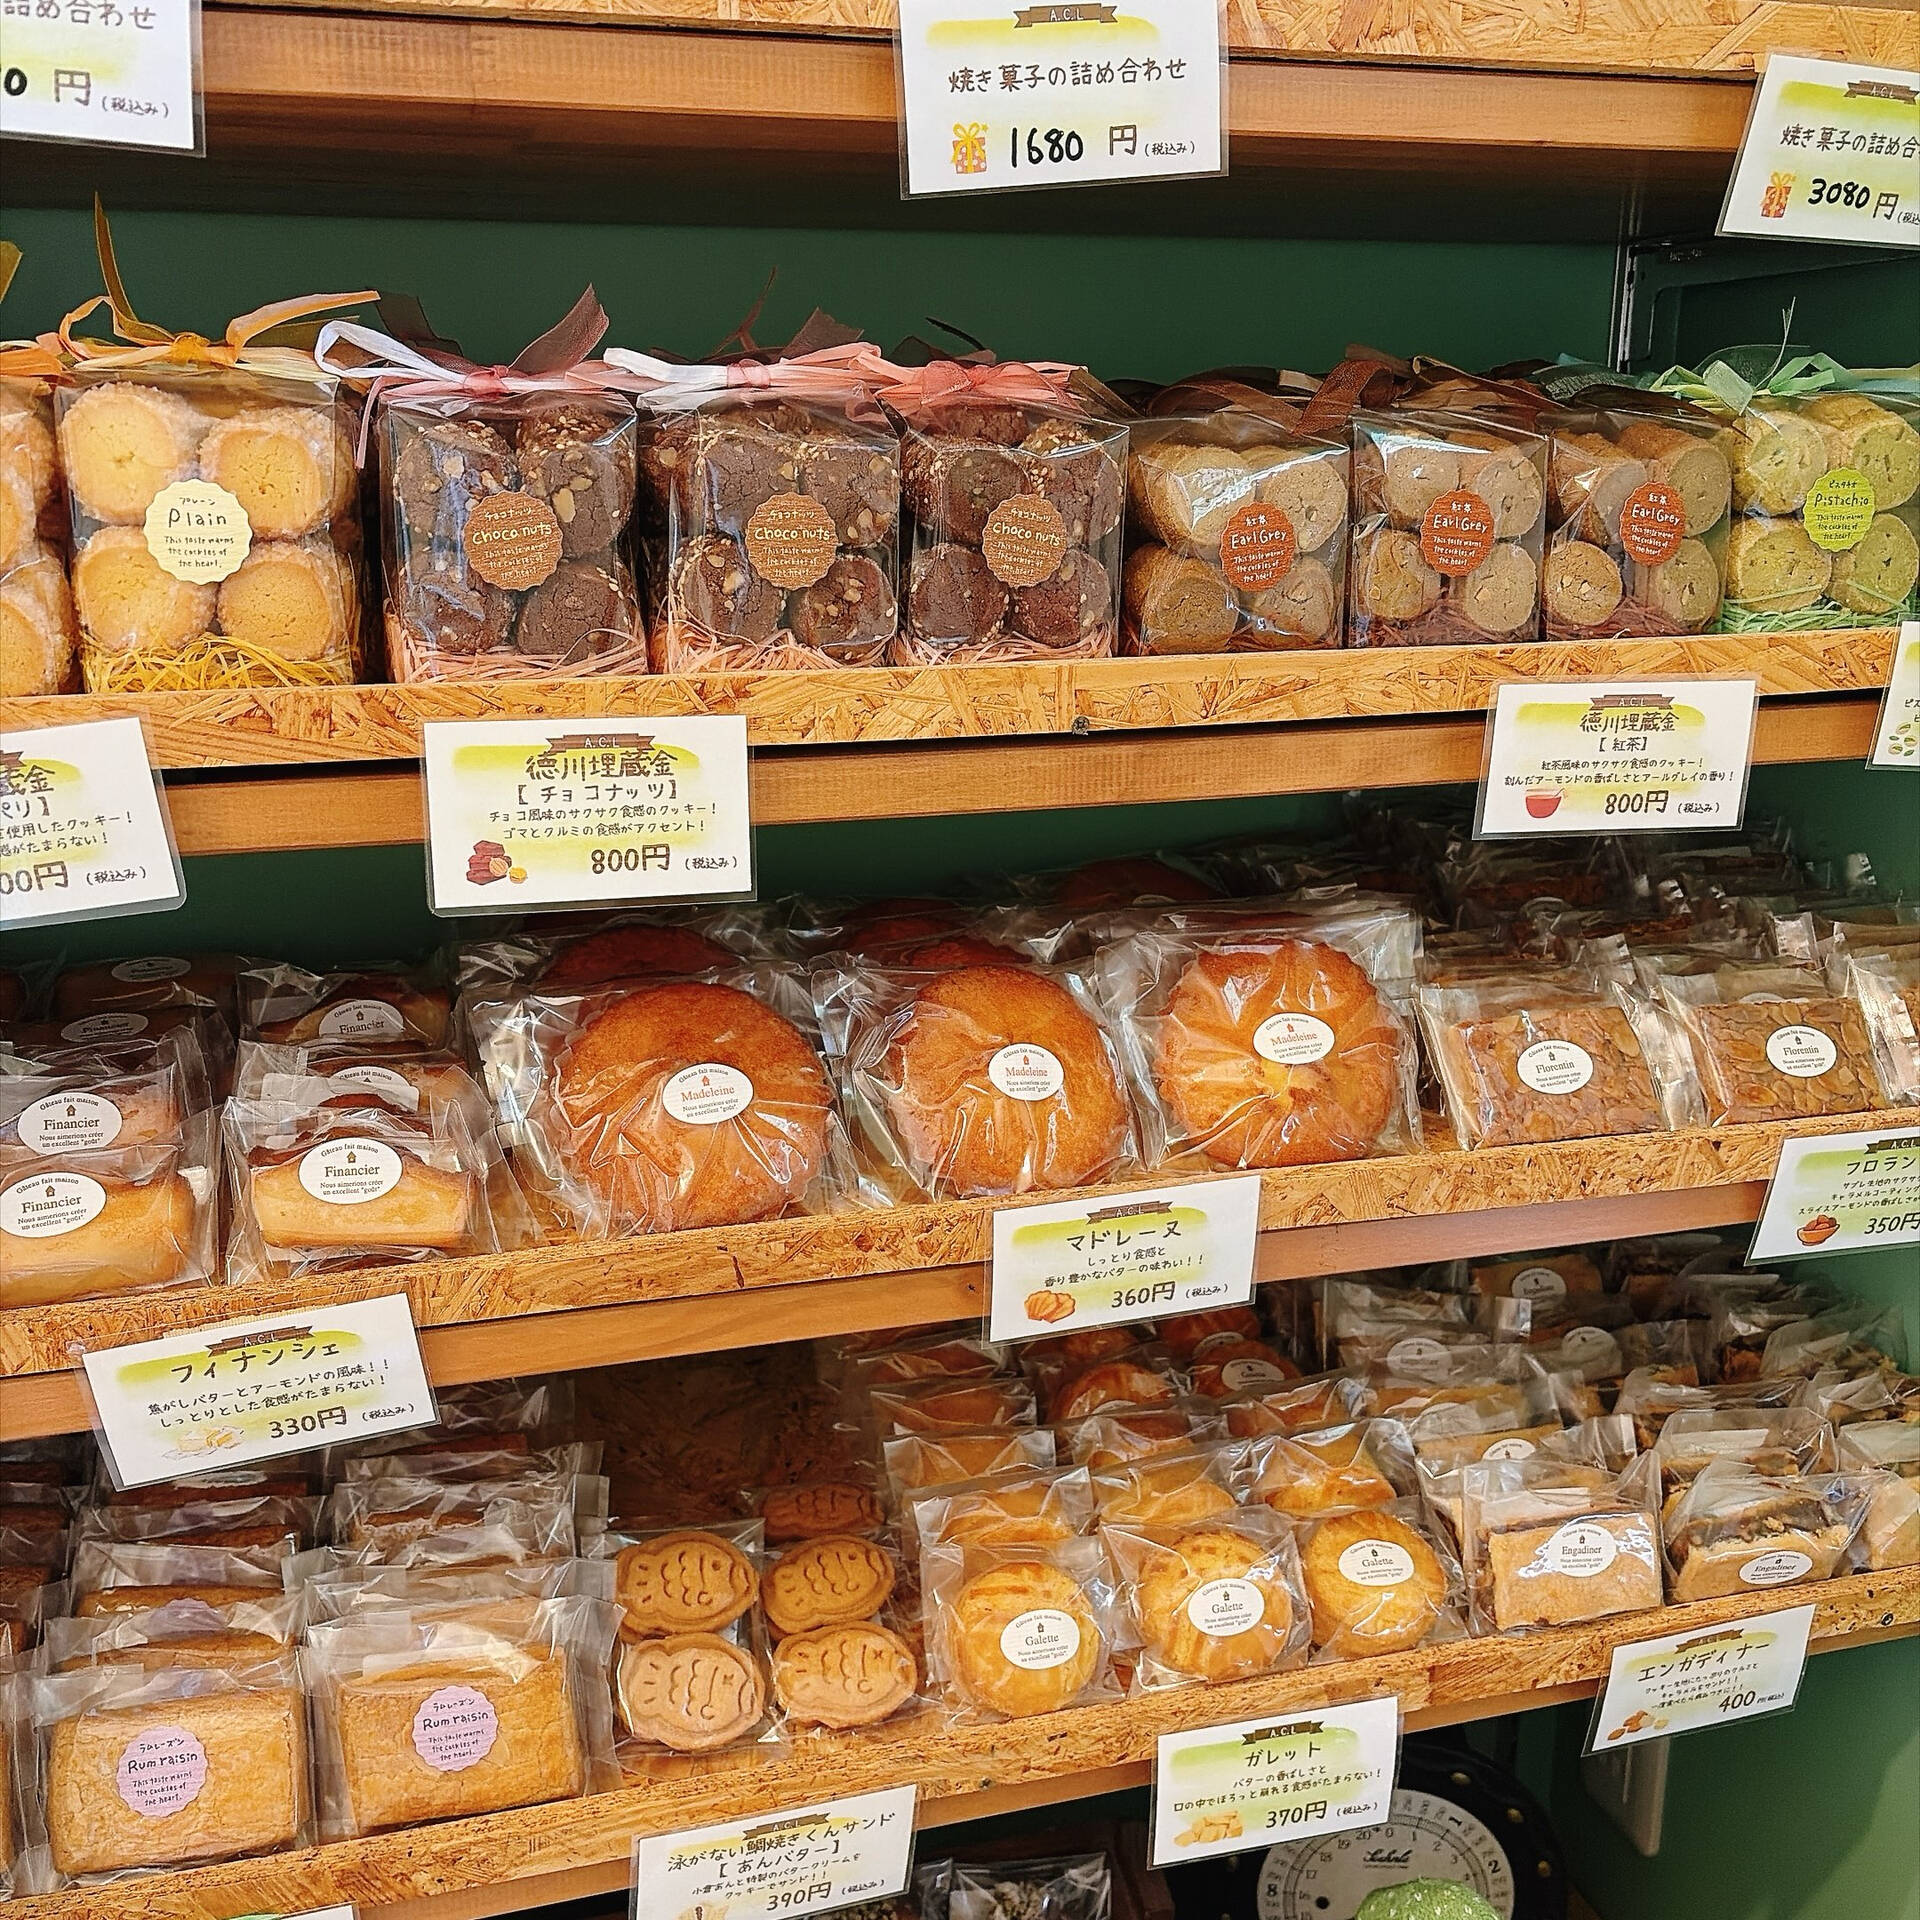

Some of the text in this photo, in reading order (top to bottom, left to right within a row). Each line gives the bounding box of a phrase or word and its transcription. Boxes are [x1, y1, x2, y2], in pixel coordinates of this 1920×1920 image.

[1049, 7, 1084, 22] A.C.L
[948, 57, 1188, 93] 焼き菓子の詰め合わせ
[1010, 126, 1084, 168] 1680
[1779, 123, 1920, 160] 焼き菓子の詰め合
[1814, 492, 1869, 508] Pistachio
[168, 507, 227, 528] Plain
[1433, 514, 1489, 533] Earl Grey
[1631, 503, 1681, 525] Earl Grey
[472, 522, 553, 545] Choco nuts
[754, 526, 831, 541] Choco nuts
[992, 521, 1061, 547] Choco nuts
[1231, 529, 1287, 549] Earl Grey
[1579, 711, 1680, 734] 徳川埋蔵金
[1598, 737, 1649, 752] 【紅茶】
[525, 749, 679, 781] 徳川埋蔵金
[1604, 790, 1669, 814] 800円
[590, 843, 670, 875] 800円
[339, 1019, 385, 1034] Financier
[1270, 1032, 1318, 1046] Madeleine
[1782, 1045, 1820, 1056] Florentin
[1004, 1066, 1048, 1077] Madeleine
[1535, 1060, 1575, 1073] Florentin
[680, 1086, 735, 1102] Madeleine
[43, 1117, 100, 1130] Financier
[324, 1164, 380, 1177] Financier
[21, 1195, 82, 1214] Financier
[1066, 1220, 1183, 1252] マドレーヌ
[1087, 1246, 1167, 1267] しっとり食感と
[1111, 1280, 1176, 1308] 360円
[170, 1342, 341, 1383] フィナンシェ
[268, 1405, 347, 1439] 330円
[1561, 1545, 1602, 1557] Engadiner
[1211, 1602, 1244, 1614] Galette
[1025, 1634, 1060, 1646] Galette
[1637, 1643, 1770, 1682] エンガディナー
[1718, 1690, 1756, 1713] 400
[422, 1711, 489, 1731] Rum raisin
[139, 1737, 185, 1753] ラムレーズン
[1245, 1741, 1321, 1768] ガレット
[127, 1752, 198, 1774] Rum raisin
[1232, 1765, 1326, 1789] バターの香ばしさと
[1265, 1800, 1328, 1829] 370円
[766, 1881, 832, 1911] 390円
